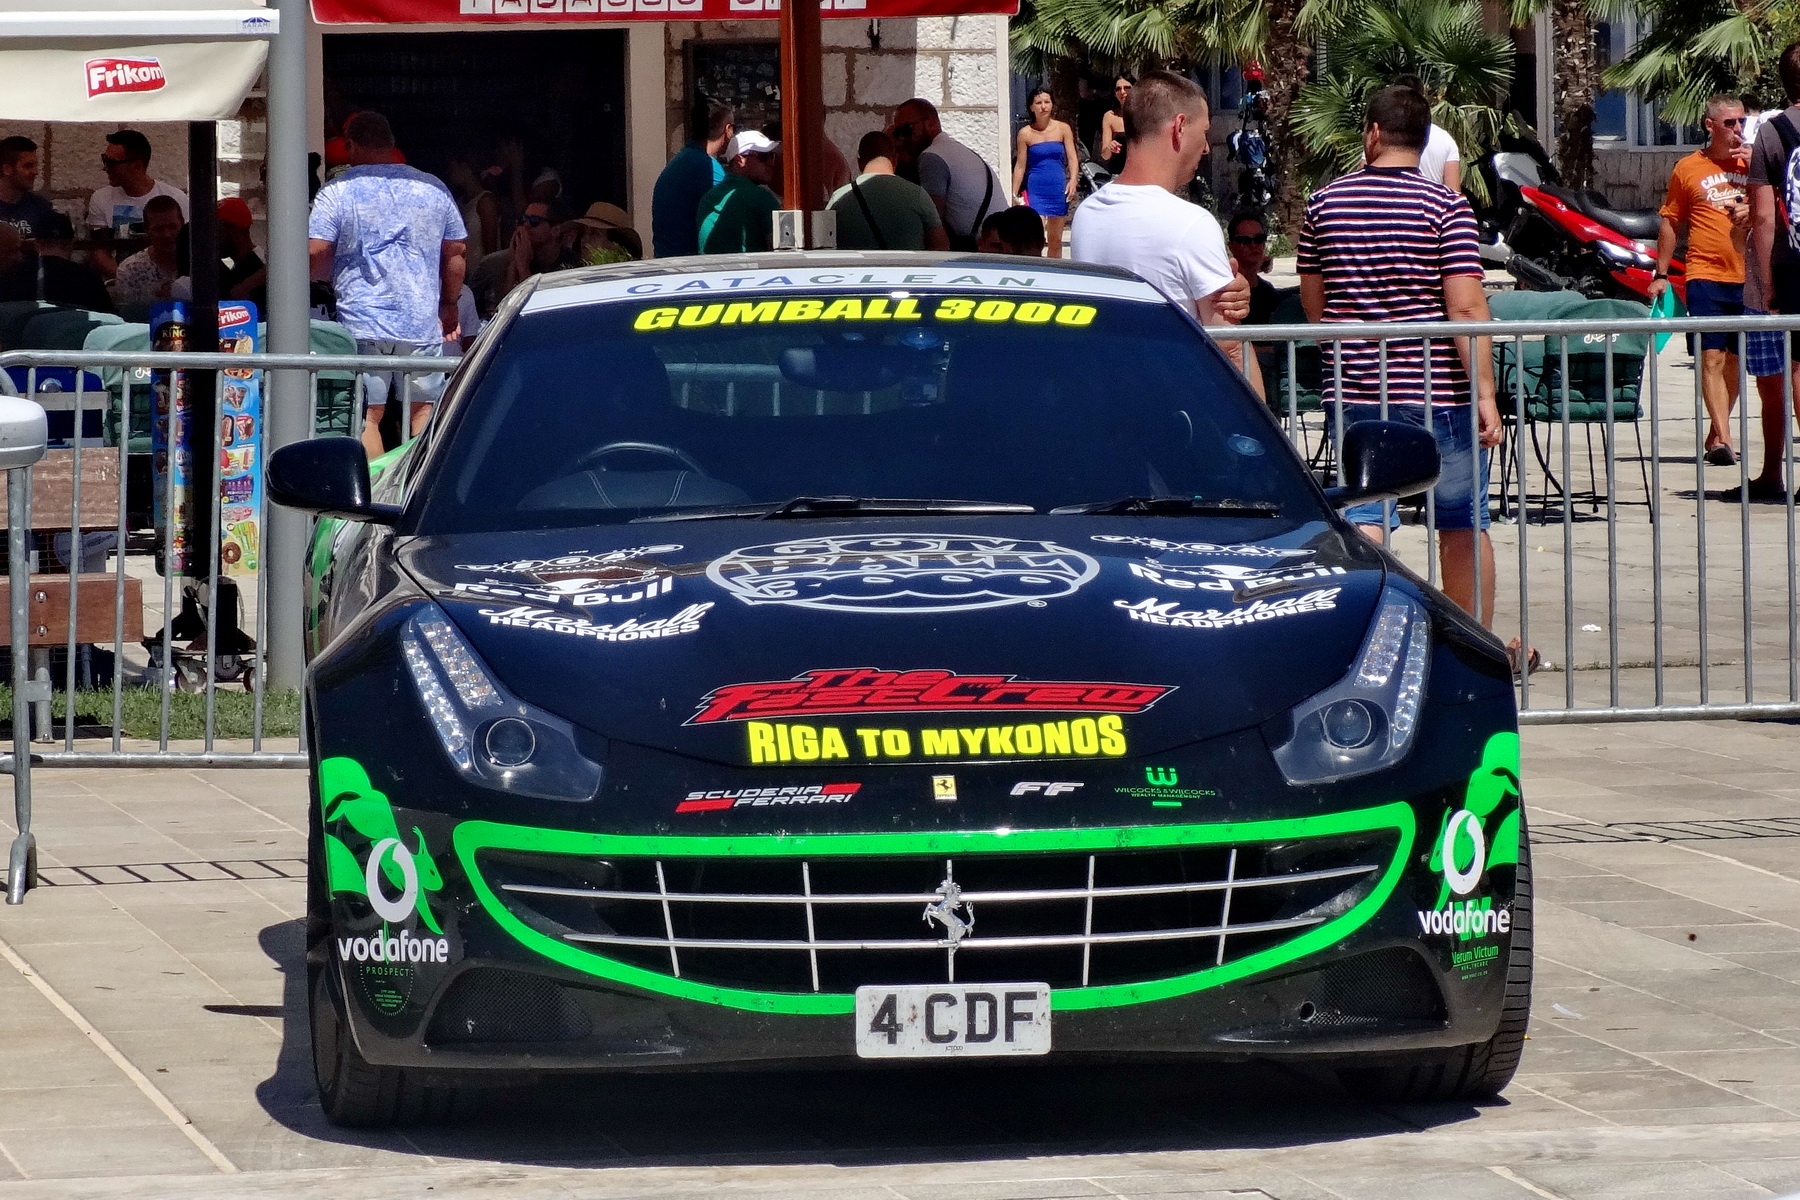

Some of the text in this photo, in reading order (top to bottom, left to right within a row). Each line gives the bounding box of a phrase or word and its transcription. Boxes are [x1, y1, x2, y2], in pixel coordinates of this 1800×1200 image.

[89, 64, 165, 90] Frikom
[626, 274, 1035, 294] CATACLEAN
[219, 310, 249, 324] rikom
[633, 299, 1097, 330] GUMBALL 3000
[454, 576, 673, 606] Red Bull
[731, 572, 1081, 605] 3000
[1128, 563, 1347, 591] Red Bull
[478, 602, 715, 634] Marshall
[1113, 588, 1342, 620] Marshall
[1129, 600, 1337, 628] HEADPHONES
[489, 616, 700, 641] HEADPHONES
[747, 714, 1127, 764] RIGA TO MYKONOS
[685, 785, 824, 800] SCUDERIA
[733, 794, 853, 807] FERRARI
[1010, 781, 1085, 796] FF
[1417, 901, 1511, 934] vodafone
[337, 929, 449, 962] vodafone
[1452, 945, 1499, 964] Verum Victum
[366, 966, 410, 977] PROSPECT
[869, 991, 1038, 1045] 4 CDF
